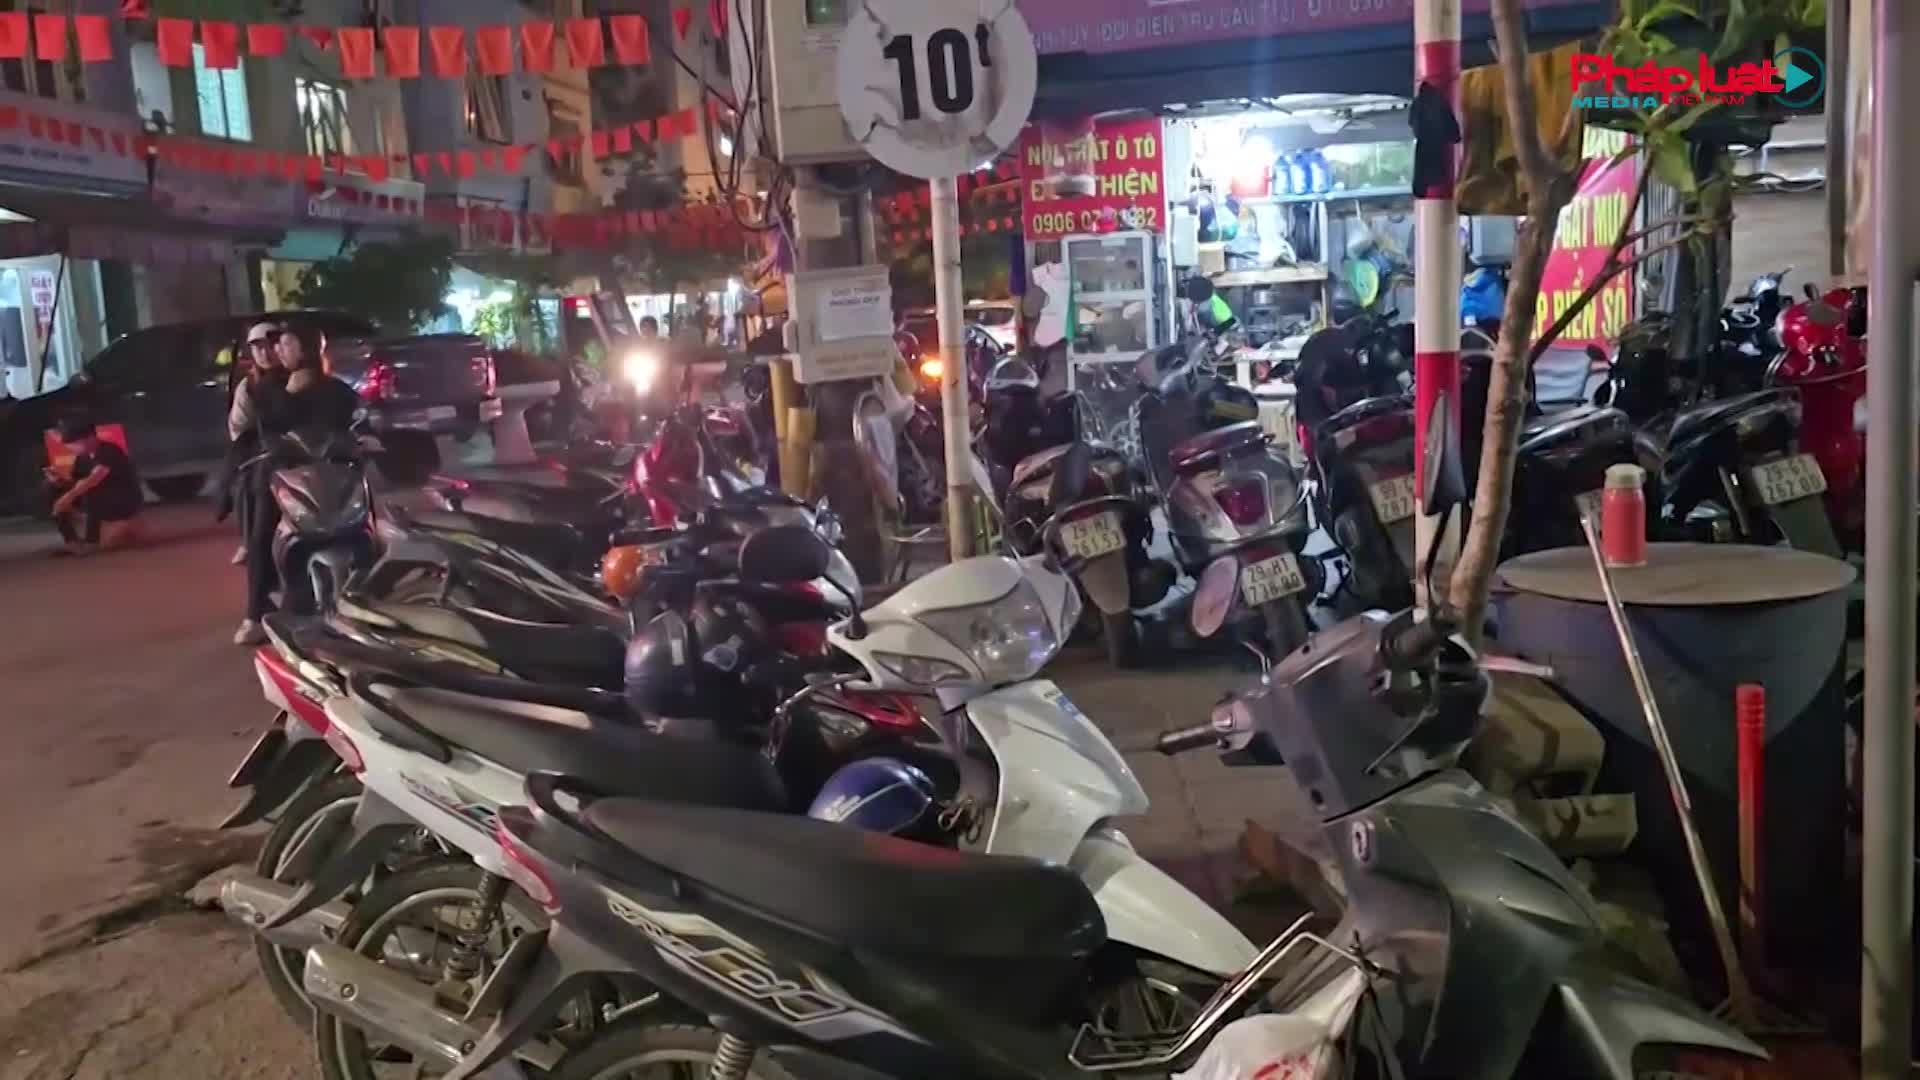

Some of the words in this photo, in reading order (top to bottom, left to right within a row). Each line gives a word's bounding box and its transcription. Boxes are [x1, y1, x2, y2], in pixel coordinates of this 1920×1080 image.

[1115, 136, 1128, 159] Ô
[1133, 133, 1156, 159] TÔ
[1033, 211, 1075, 233] 0906
